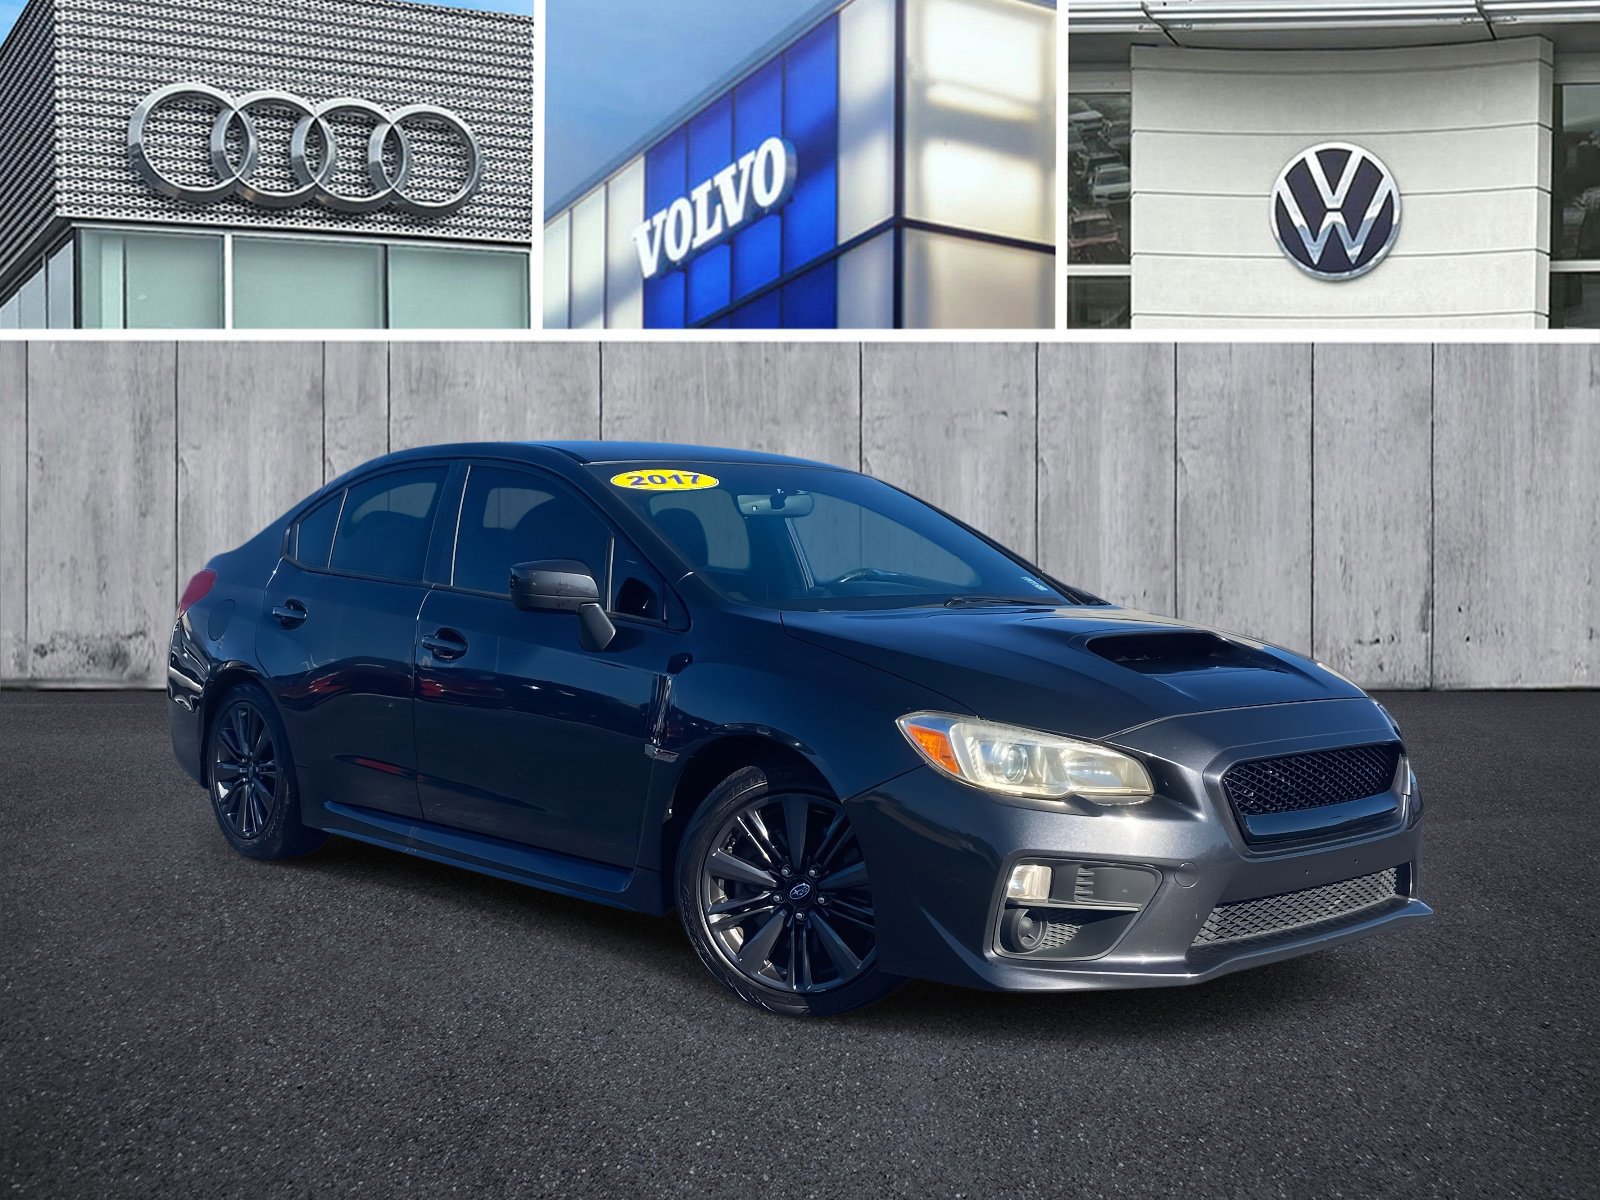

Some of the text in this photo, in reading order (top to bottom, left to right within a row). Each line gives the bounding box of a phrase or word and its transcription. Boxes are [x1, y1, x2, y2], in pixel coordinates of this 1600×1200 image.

[632, 136, 788, 279] VOLVO
[1273, 145, 1399, 268] VW
[626, 473, 701, 487] 2017
